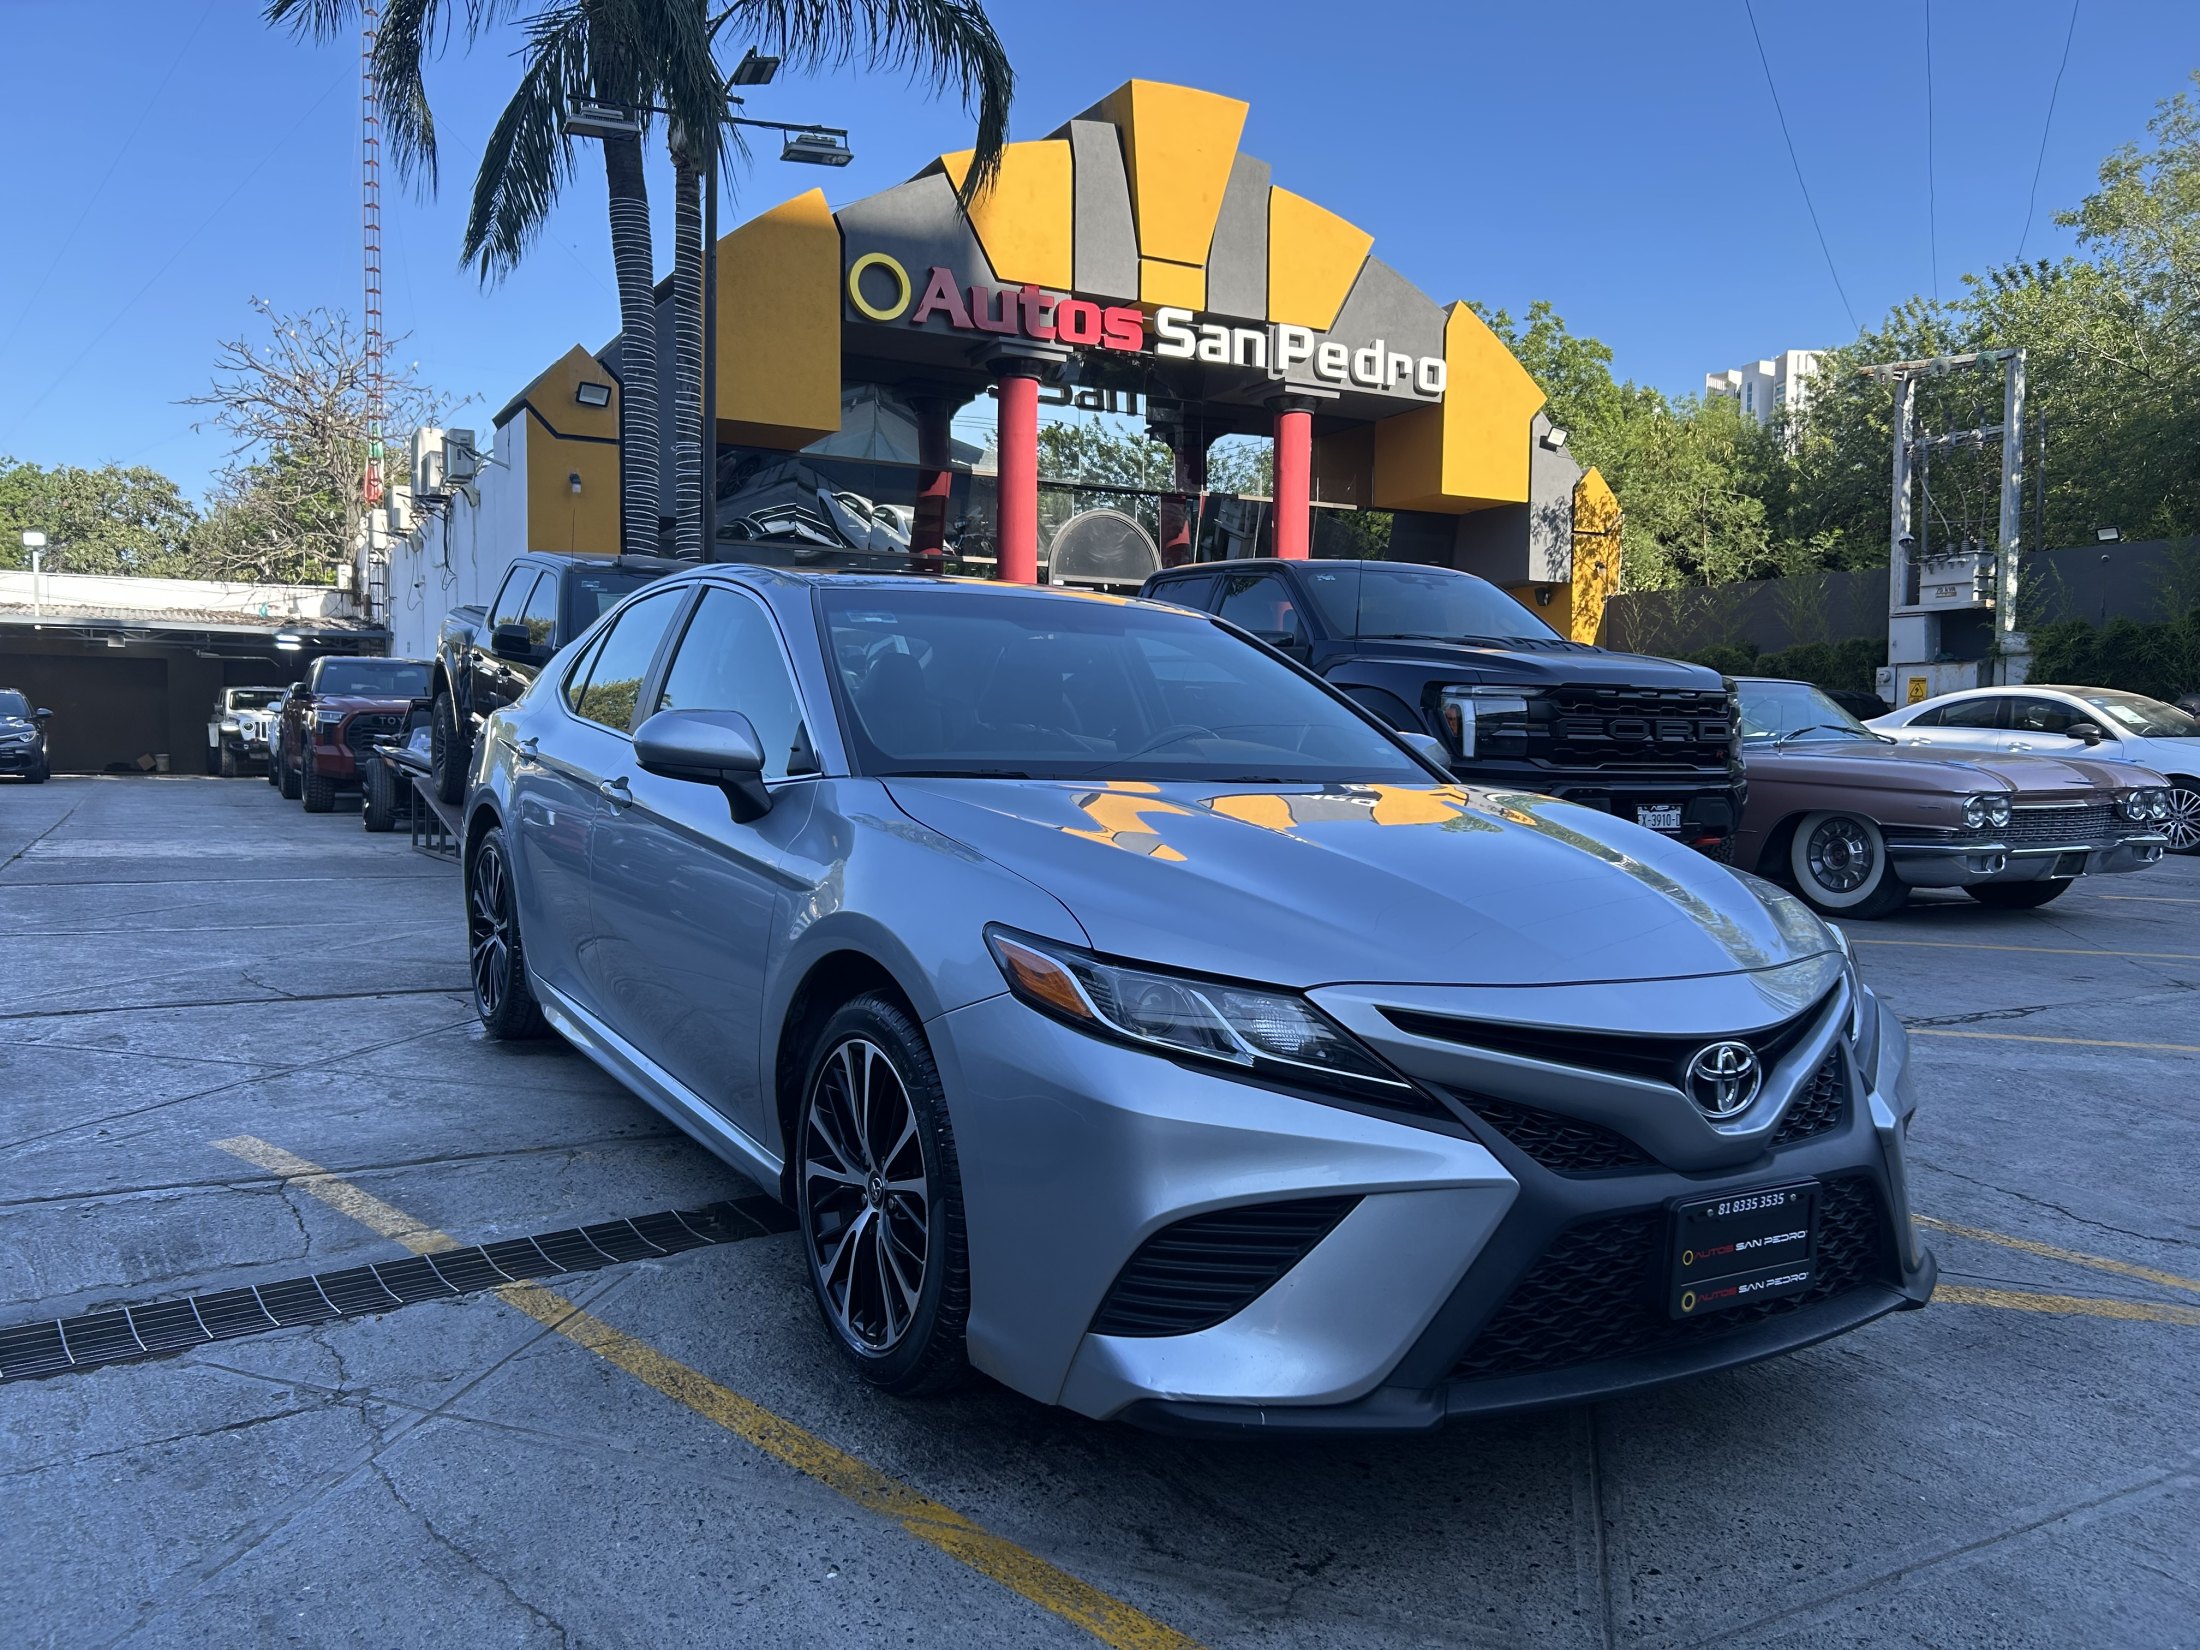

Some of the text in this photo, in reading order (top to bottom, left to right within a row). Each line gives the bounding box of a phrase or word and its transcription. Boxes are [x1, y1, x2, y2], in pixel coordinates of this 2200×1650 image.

[912, 266, 1447, 393] Autos San Pedro
[1552, 718, 1732, 742] FORD
[1718, 1193, 1784, 1215] 81 8335 3535
[1694, 1230, 1807, 1258] AUTOS SAN PEDRO
[1698, 1272, 1808, 1301] AUTOS SAN PEDRO
